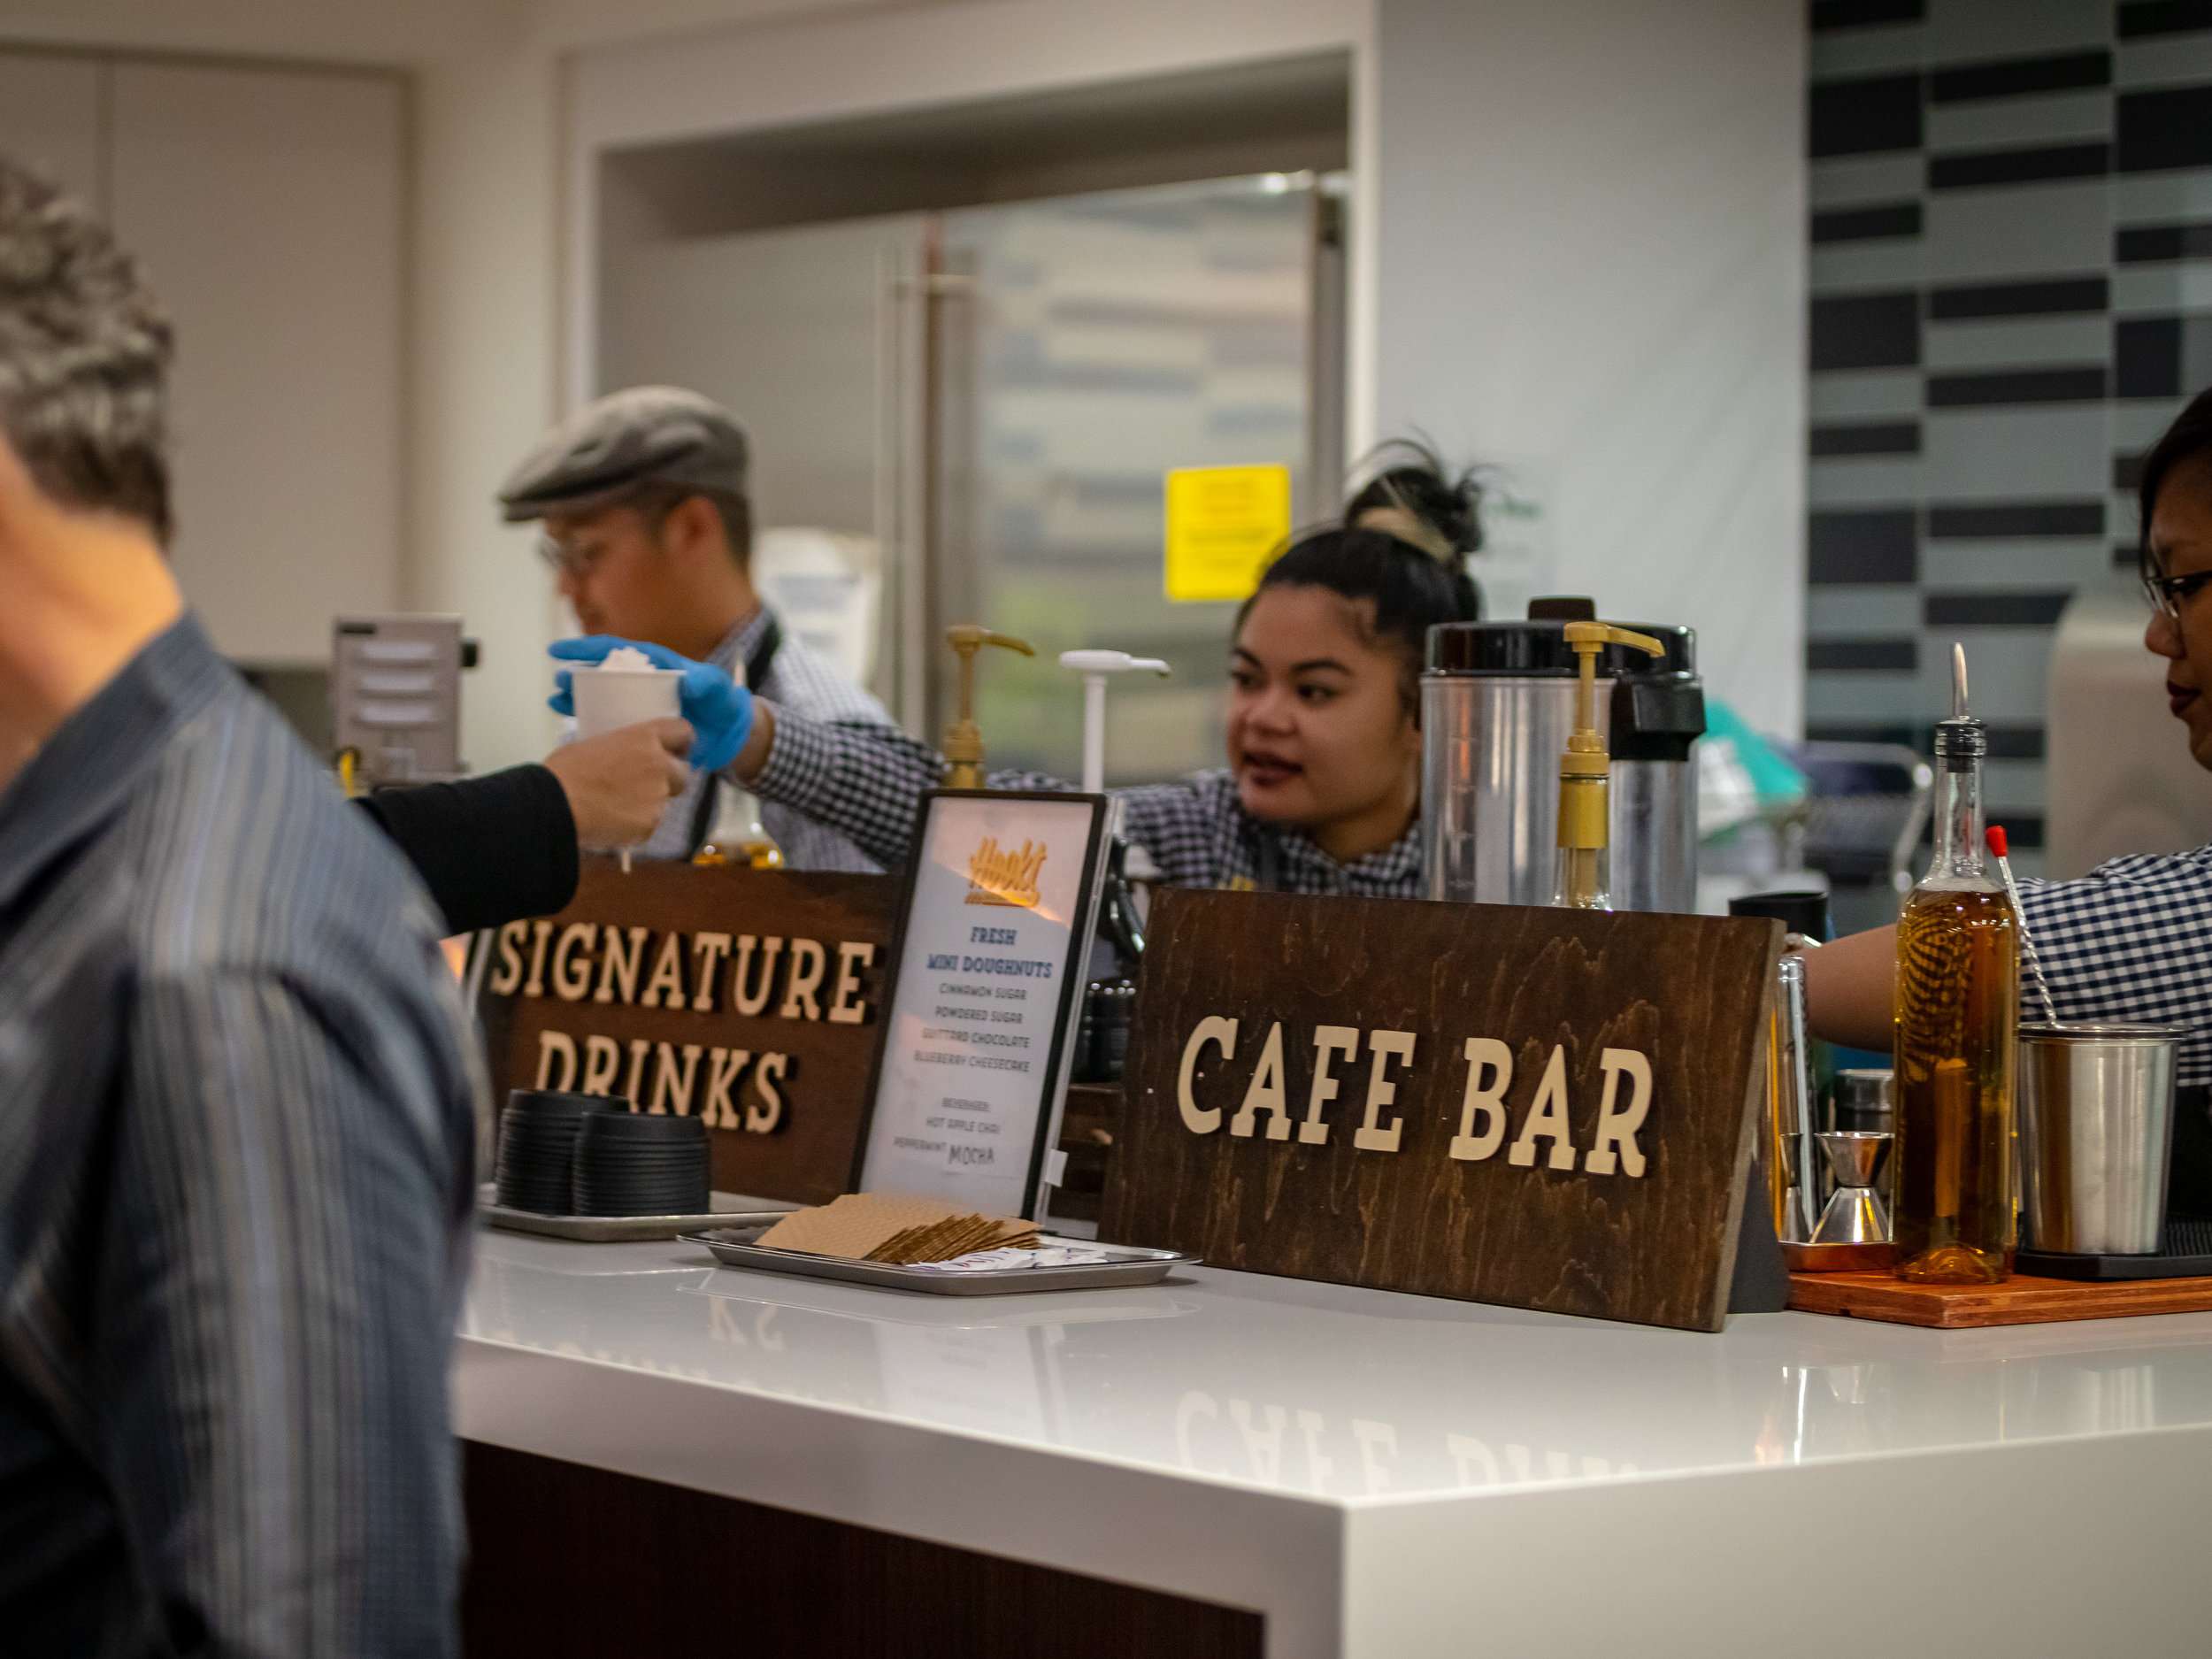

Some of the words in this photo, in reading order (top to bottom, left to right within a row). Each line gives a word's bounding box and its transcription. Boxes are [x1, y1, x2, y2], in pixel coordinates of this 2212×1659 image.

[970, 926, 1018, 946] FRESH
[489, 918, 874, 1025] SIGNATURE
[926, 953, 959, 972] MINI
[962, 956, 1053, 979] DOUGHNUTS
[939, 982, 992, 997] CINNAMON
[995, 987, 1026, 1001] SUGAR
[934, 1005, 988, 1021] POWDERED
[990, 1010, 1023, 1024] SUGAR
[971, 1032, 1030, 1048] CHOCOLATE
[914, 1049, 966, 1065] BLUEBERRY
[969, 1056, 1030, 1072] CHEESECAKE
[534, 1030, 787, 1134] DRINKS
[1177, 1015, 1416, 1153] CAFE
[1448, 1037, 1653, 1178] BAR
[947, 1118, 975, 1132] APPLE
[948, 1145, 995, 1164] MOCHA
